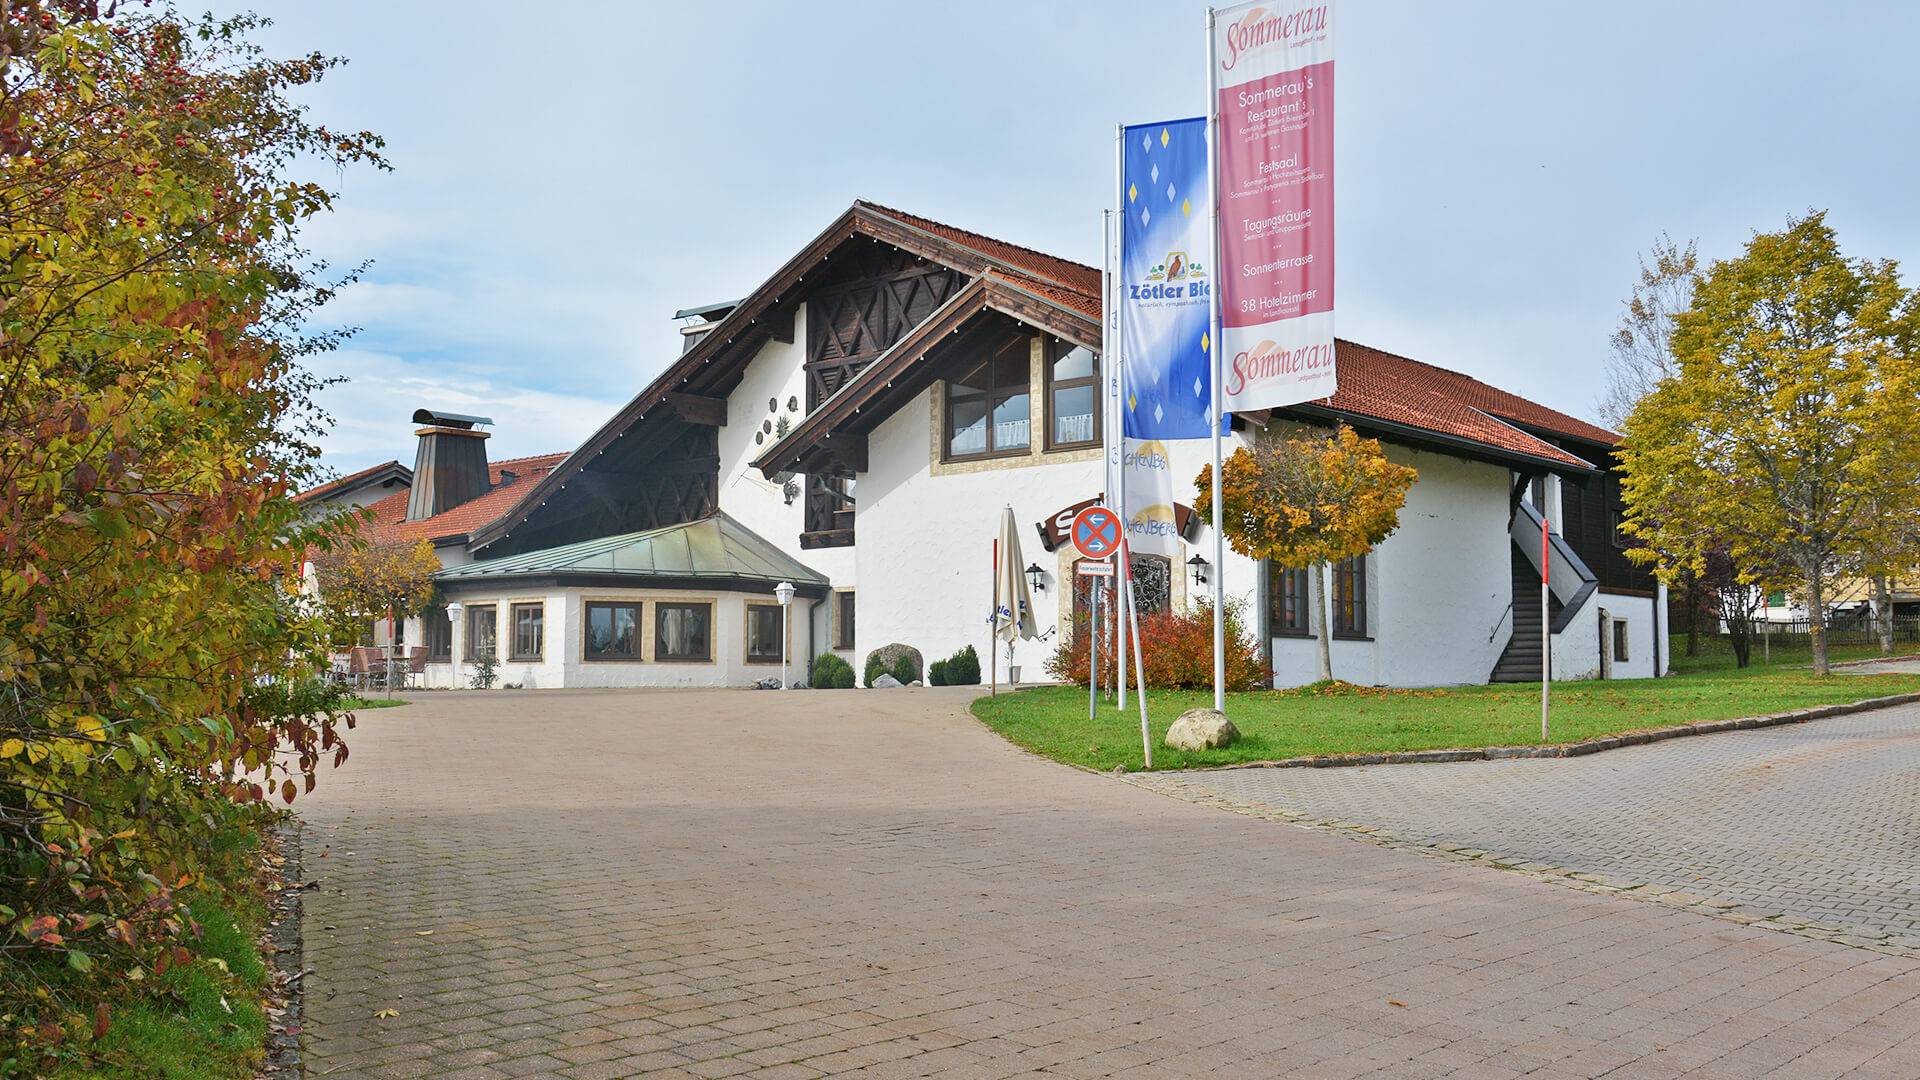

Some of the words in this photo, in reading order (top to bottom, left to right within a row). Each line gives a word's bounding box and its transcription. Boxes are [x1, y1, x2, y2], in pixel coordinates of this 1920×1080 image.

[1222, 6, 1327, 71] Sommerau
[1259, 153, 1297, 174] Festsaal
[1243, 208, 1311, 233] Tagungsräume
[1243, 253, 1313, 277] Sonnenterrasse
[1130, 283, 1184, 300] Zötler
[1241, 299, 1256, 313] 38
[1260, 289, 1317, 310] Hotelzimmer
[1226, 343, 1332, 396] Sommerau
